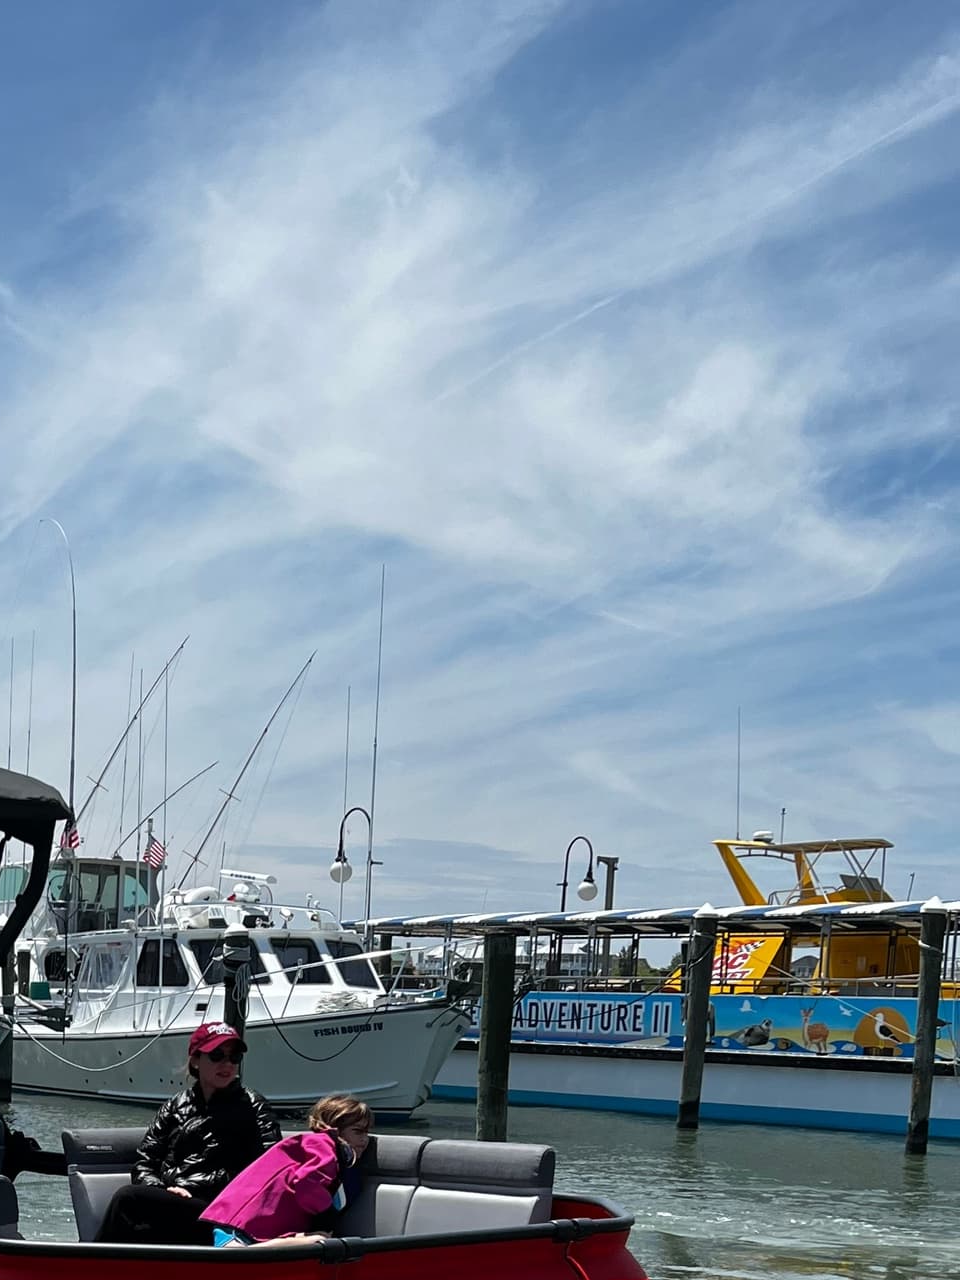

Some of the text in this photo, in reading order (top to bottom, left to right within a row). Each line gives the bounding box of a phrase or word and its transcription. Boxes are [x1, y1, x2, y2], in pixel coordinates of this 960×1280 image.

[513, 1001, 643, 1034] ADVENTURE
[653, 1003, 671, 1034] II
[313, 1022, 384, 1038] FISH BOUND IV
